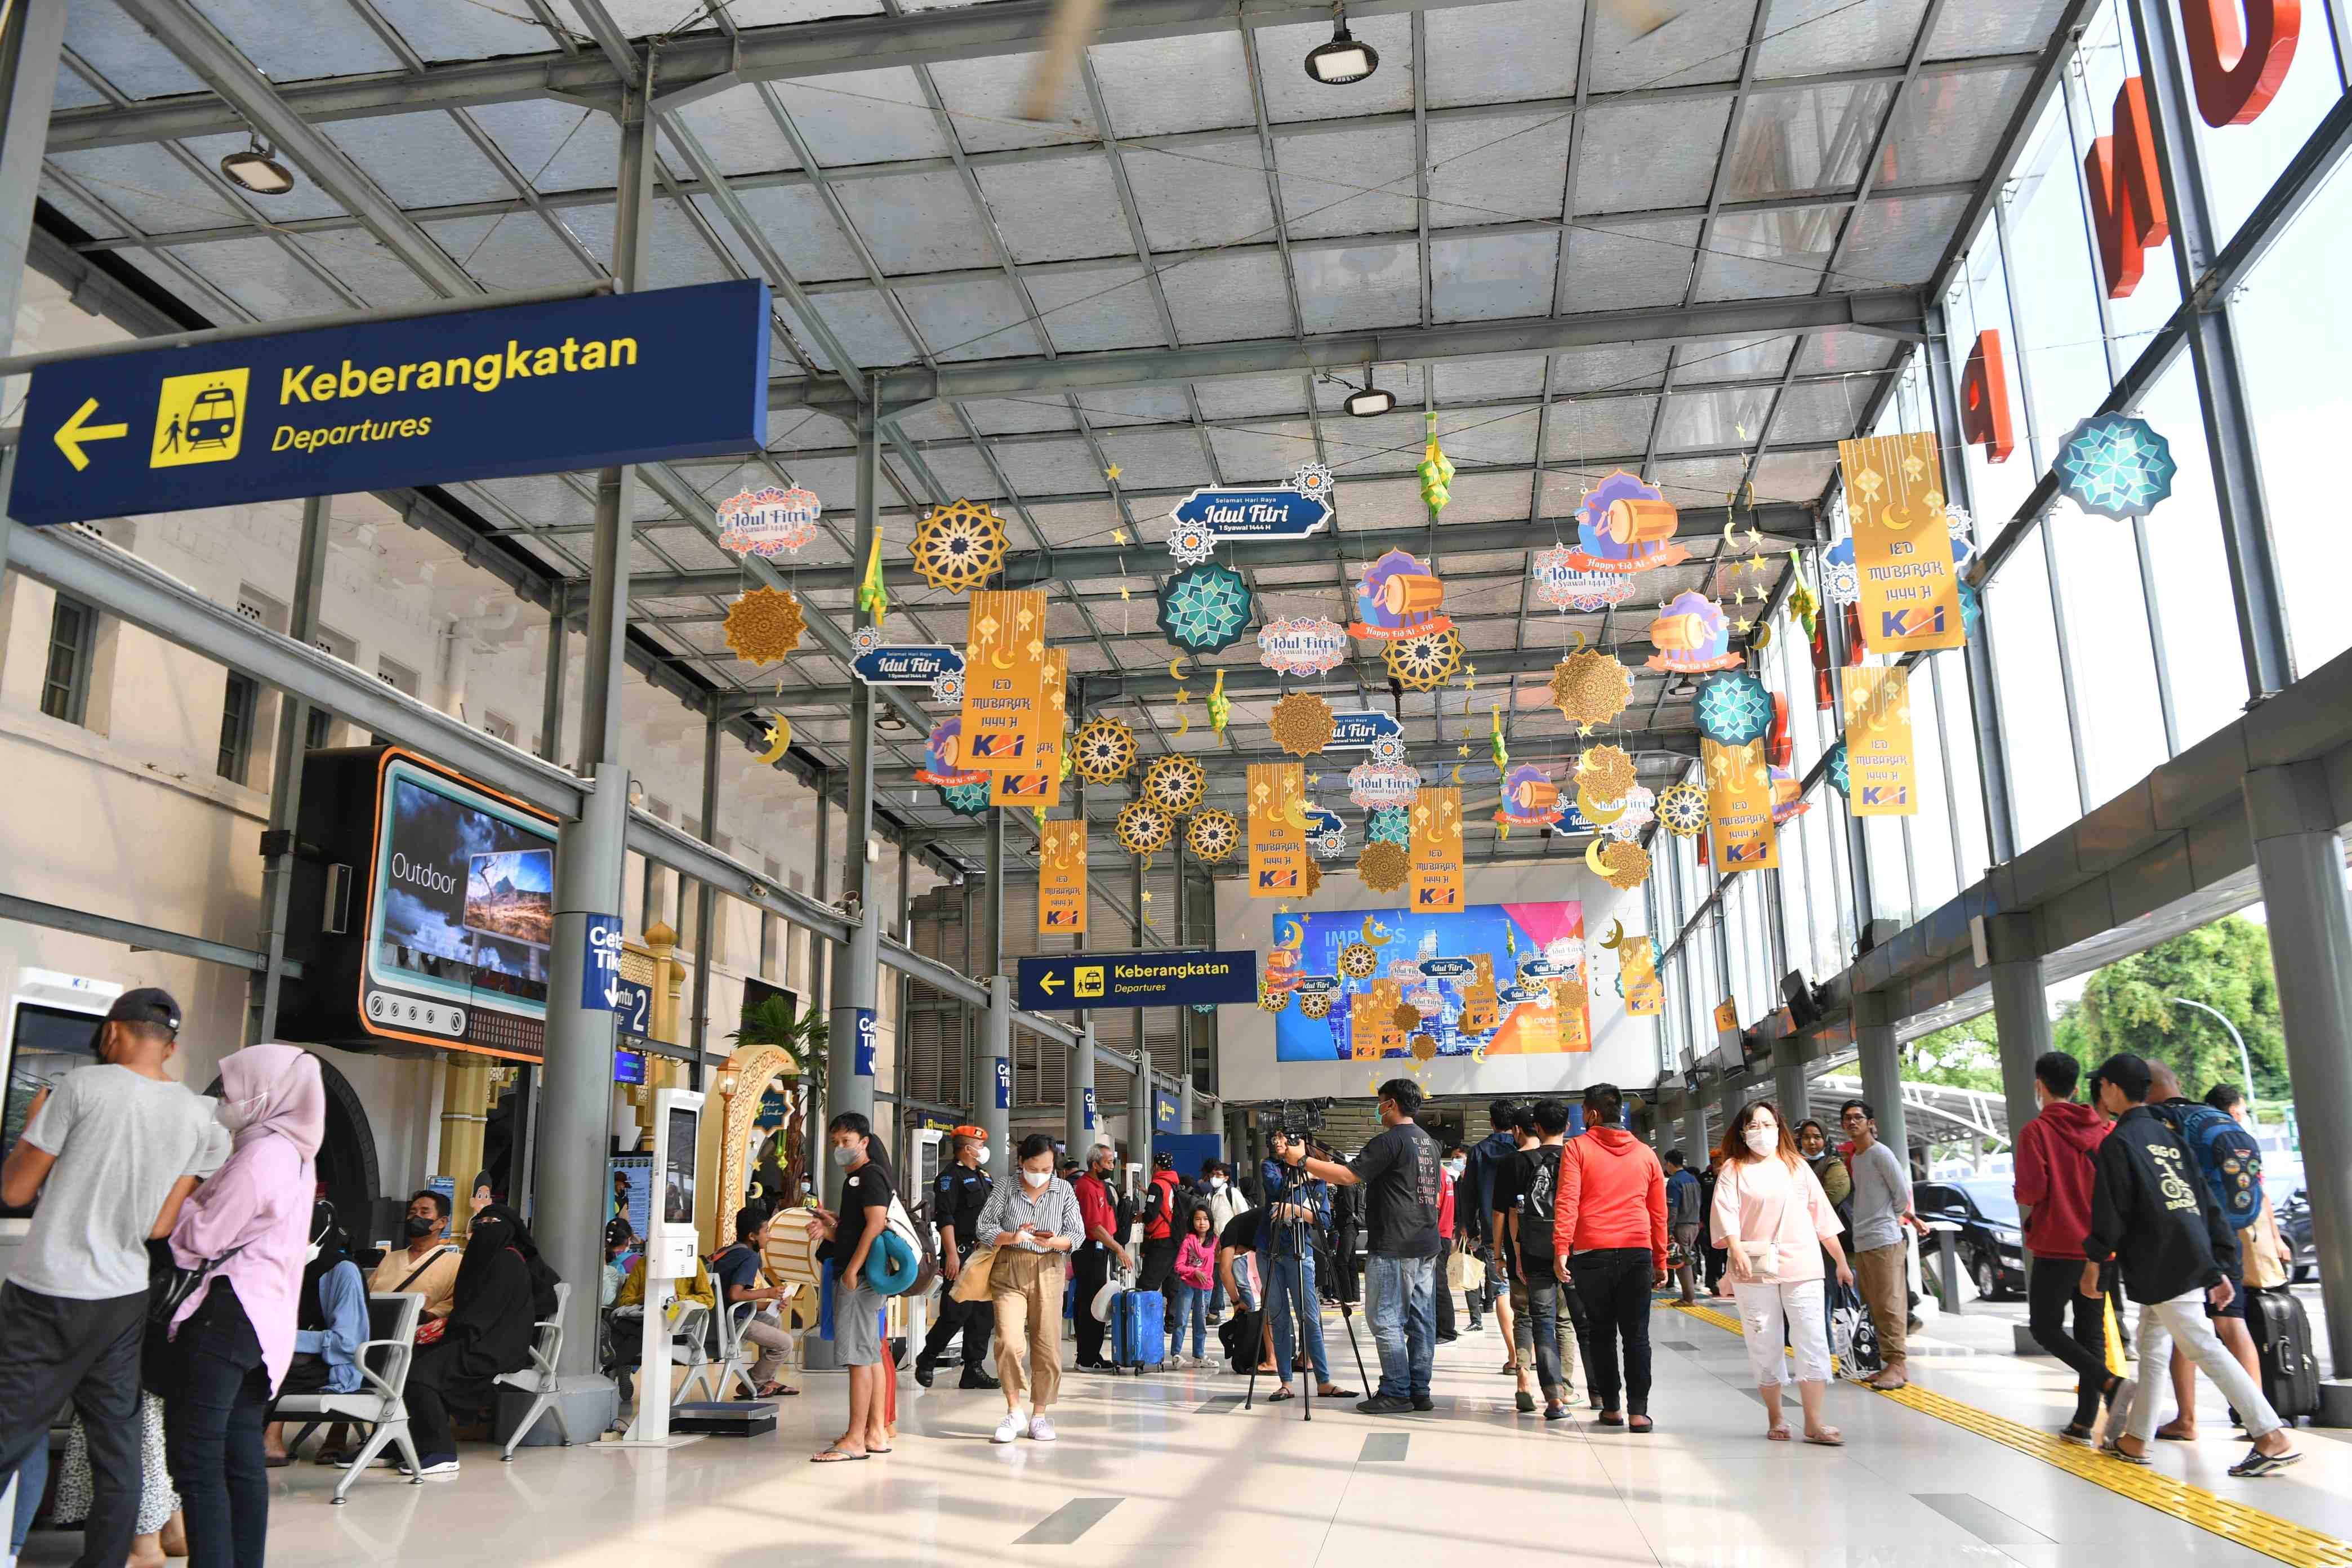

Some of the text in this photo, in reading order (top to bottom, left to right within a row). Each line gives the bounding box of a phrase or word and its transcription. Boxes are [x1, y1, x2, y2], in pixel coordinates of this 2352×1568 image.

[280, 338, 637, 405] Keberangkatan
[271, 417, 433, 453] Departures
[731, 509, 805, 527] Idul Fitri
[1205, 505, 1289, 523] Idul Fitri
[1890, 541, 1915, 555] IED
[1586, 558, 1615, 571] Happy
[1650, 554, 1667, 564] Fitr
[1867, 561, 1945, 580] MUBARAK
[1558, 578, 1586, 588] Syawal
[1886, 585, 1932, 602] 1444 H
[1882, 605, 1945, 637] KAI
[1364, 626, 1389, 638] Happy
[1271, 637, 1334, 648] Idul Fitri
[879, 658, 941, 672] Idul Fitri
[1663, 660, 1686, 670] Happy
[993, 680, 1012, 691] IED
[971, 698, 1032, 711] MUBARAK
[982, 717, 1018, 729] 1444 H
[1348, 724, 1376, 737] Fitri
[972, 735, 1025, 756] KAI
[1872, 740, 1888, 749] IED
[1855, 756, 1909, 766] MUBARAK
[1867, 771, 1898, 781] 1444 H
[1002, 775, 1049, 794] KAI
[1358, 778, 1410, 789] Idul Fitri
[1863, 786, 1906, 805] KAI
[1732, 801, 1748, 810] IED
[1505, 816, 1521, 825] Happy
[1570, 814, 1593, 826] Idu
[1718, 814, 1767, 826] MUBARAK
[1270, 829, 1284, 838] IED
[1730, 829, 1758, 839] 1444 H
[1255, 843, 1300, 853] MUBARAK
[1727, 842, 1767, 862] KAI
[1264, 856, 1291, 865] 1444 H
[1415, 862, 1458, 872] MUBARAK
[393, 853, 457, 895] Outdoor
[1259, 870, 1298, 887] KAI
[1043, 888, 1081, 896] MUBARAK
[1419, 888, 1455, 903] KAI
[1046, 910, 1078, 924] KAI
[590, 926, 622, 950] Cet
[1115, 962, 1229, 979] Keberangkatan
[1431, 964, 1447, 972] Idul
[1533, 964, 1549, 973] Idul
[1115, 984, 1166, 994] Departures
[617, 988, 634, 1006] ntu
[633, 989, 647, 1032] 2
